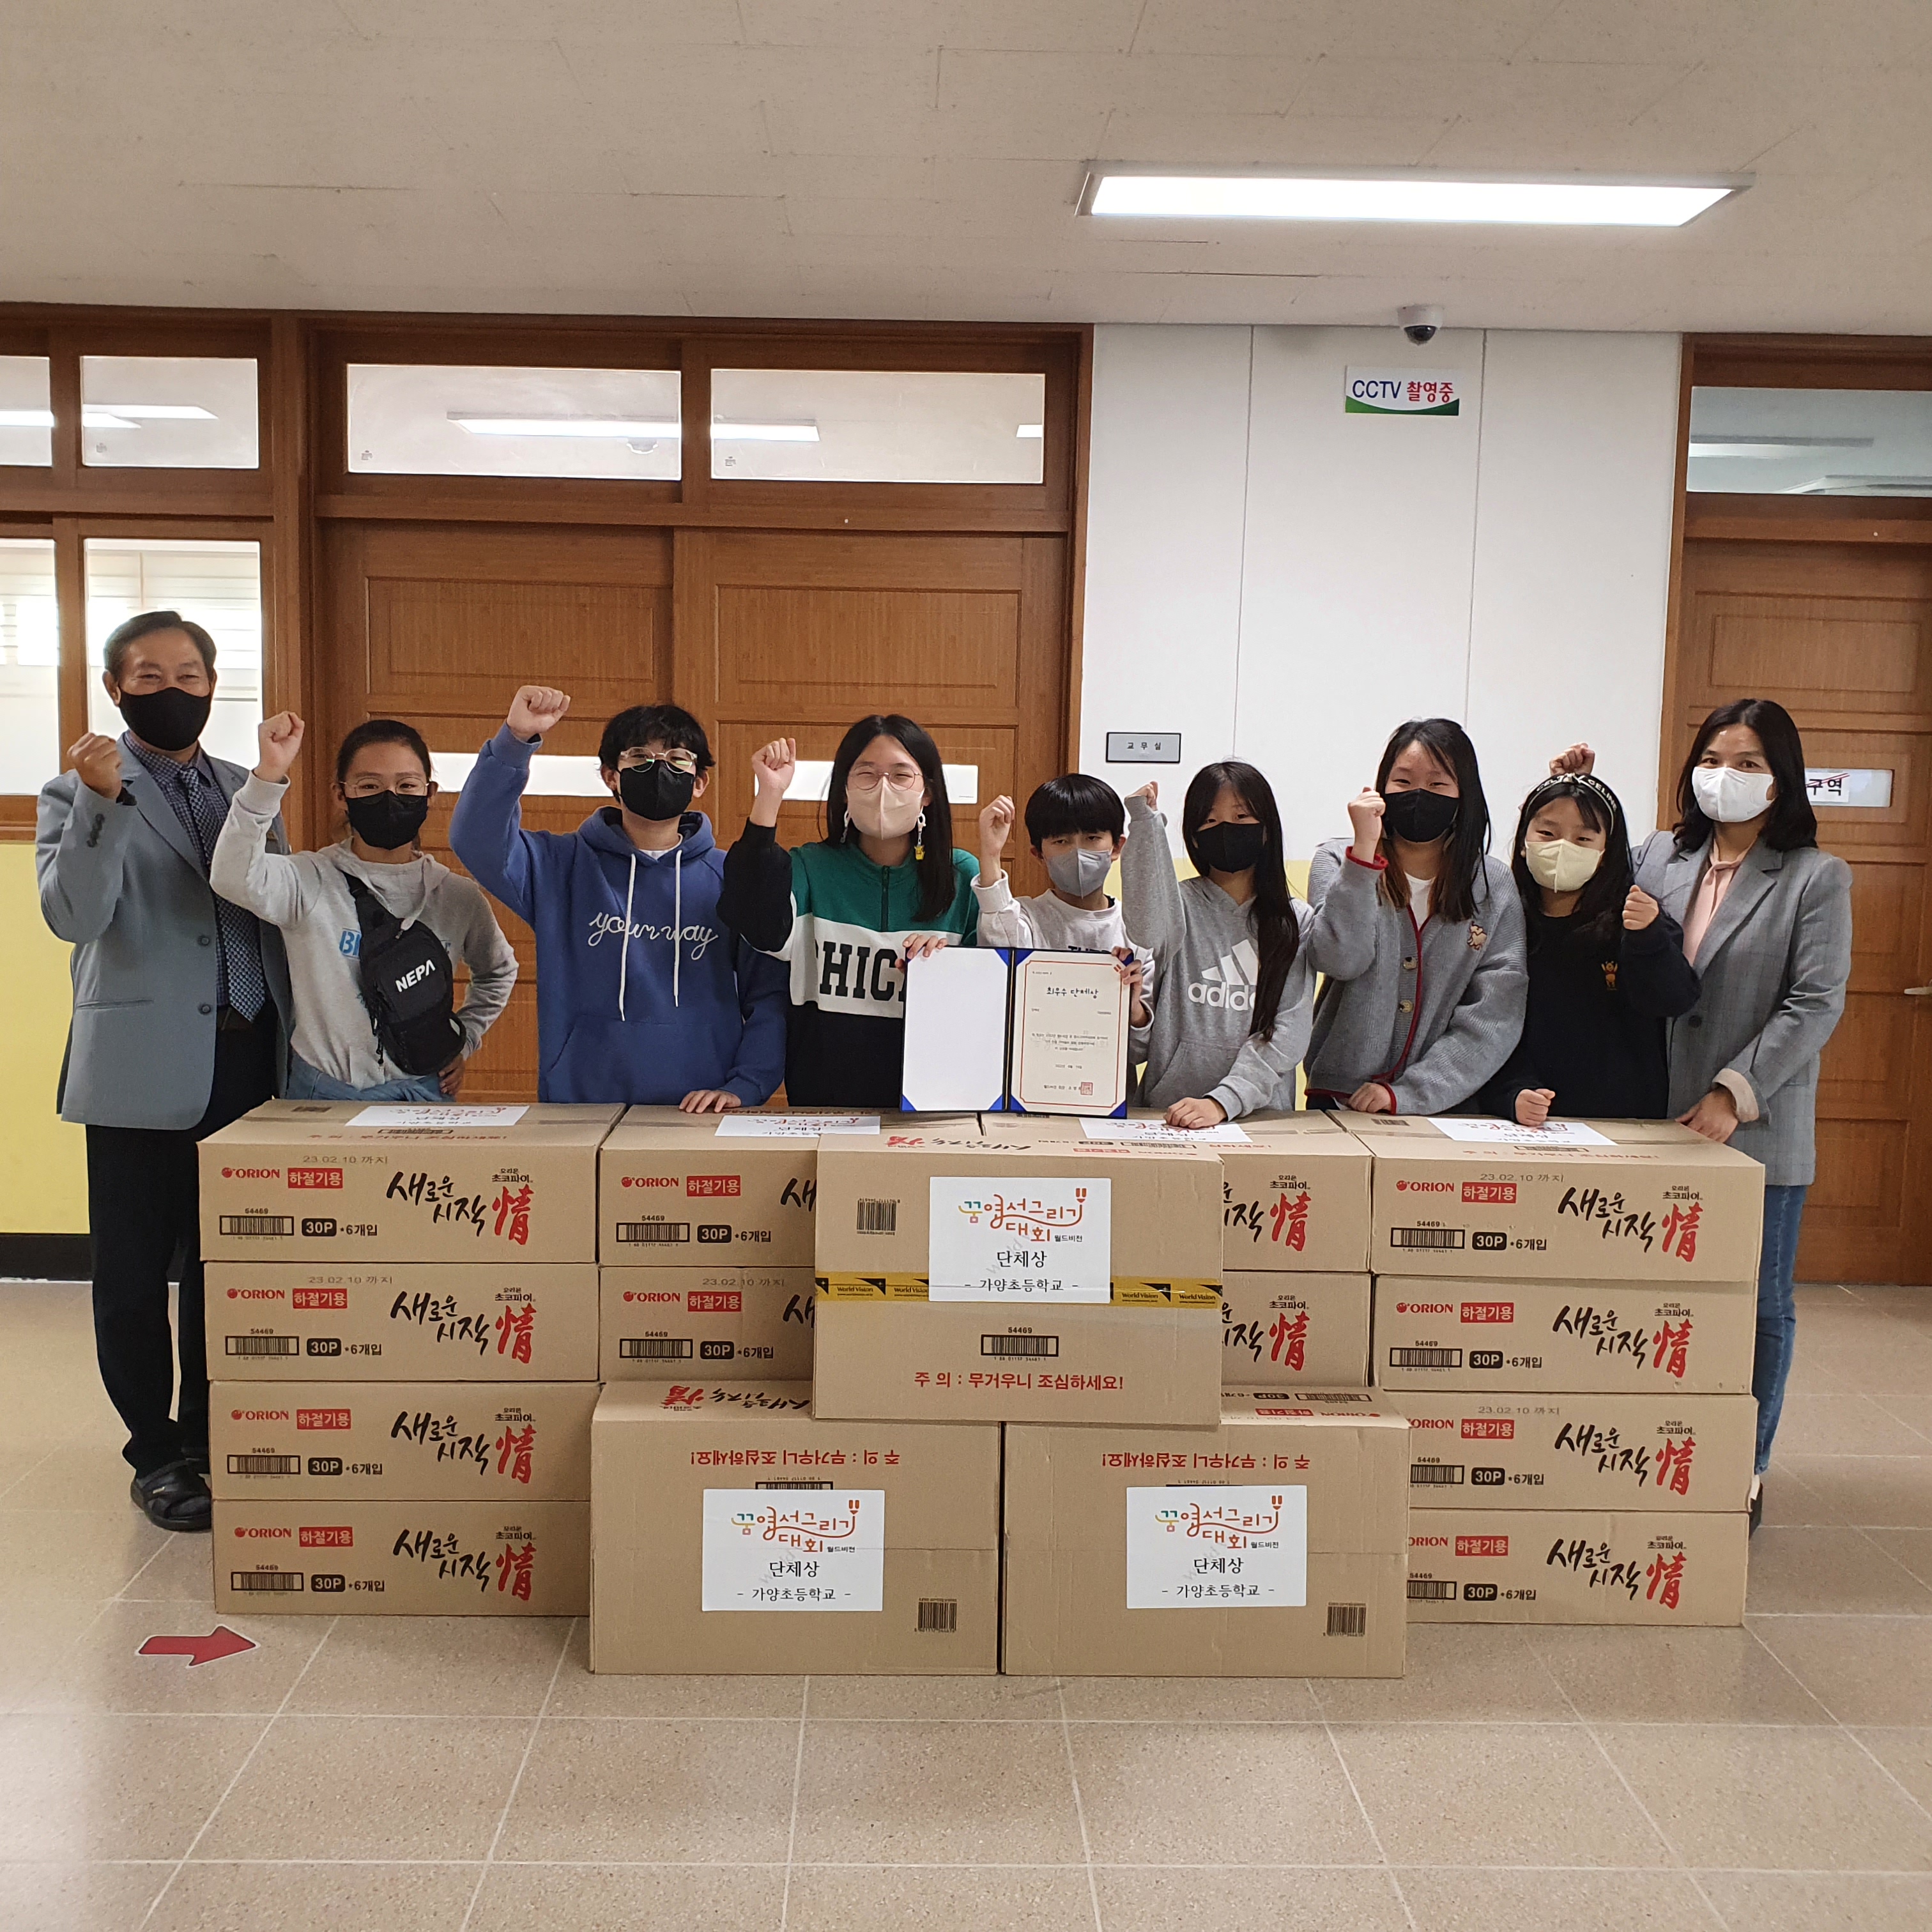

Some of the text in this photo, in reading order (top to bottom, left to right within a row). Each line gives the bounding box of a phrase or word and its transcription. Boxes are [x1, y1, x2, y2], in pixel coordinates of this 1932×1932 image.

[1353, 380, 1453, 402] CCTV 촬영중
[1588, 779, 1617, 811] CELINE
[395, 959, 436, 992] NEPA
[815, 941, 905, 1001] HIC
[1046, 986, 1098, 999] 최우수 단체상
[1188, 981, 1256, 1011] adid
[361, 1155, 388, 1165] 까지
[235, 1169, 342, 1186] ORION 하절기용
[492, 1174, 530, 1183] 초코파이
[635, 1177, 740, 1194] ORION 하절기용
[1270, 1181, 1307, 1190] 초코파이
[387, 1172, 454, 1206] 새로운
[1410, 1181, 1515, 1200] ORION 하절기용
[1662, 1192, 1699, 1200] 초코파이
[1558, 1187, 1625, 1221] 새로운
[433, 1195, 486, 1237] 시작
[492, 1183, 534, 1245] 情
[1269, 1190, 1312, 1252] 情
[306, 1222, 333, 1234] 30P
[702, 1228, 728, 1240] 30P
[1006, 1222, 1050, 1241] 대회
[1602, 1211, 1656, 1253] 시작
[1661, 1201, 1703, 1262] 情
[1476, 1235, 1503, 1247] 30P
[997, 1250, 1047, 1268] 단체상
[366, 1276, 392, 1285] 까지
[979, 1278, 1064, 1293] 가양초등학교
[240, 1289, 346, 1307] ORION 하절기용
[494, 1293, 533, 1301] 초코파이
[636, 1292, 740, 1309] ORION 하절기용
[1269, 1301, 1306, 1309] 초코파이
[390, 1292, 458, 1324] 새로운
[1409, 1303, 1513, 1321] ORION 하절기용
[1654, 1308, 1692, 1318] 초코파이
[1552, 1305, 1618, 1338] 새로운
[437, 1314, 490, 1355] 시작
[495, 1302, 537, 1364] 情
[1269, 1310, 1310, 1371] 情
[311, 1341, 338, 1353] 30P
[705, 1344, 730, 1356] 30P
[1596, 1329, 1648, 1368] 시작
[1652, 1318, 1693, 1378] 情
[1473, 1354, 1499, 1365] 30P
[968, 1372, 1031, 1390] 무거우니
[1037, 1374, 1123, 1391] 조심하세요!
[245, 1410, 349, 1427] ORION 하절기용
[495, 1413, 533, 1422] 초코파이
[1534, 1407, 1560, 1416] 까지
[390, 1411, 457, 1445] 새로운
[1411, 1418, 1513, 1437] ORION 하절기용
[1656, 1426, 1693, 1435] 초코파이
[1554, 1423, 1620, 1455] 새로운
[438, 1433, 490, 1475] 시작
[495, 1423, 537, 1484] 情
[691, 1450, 777, 1466] 조심하세요!
[783, 1449, 847, 1466] 무거우니
[1102, 1452, 1188, 1468] 조심하세요!
[1193, 1453, 1256, 1469] 무거우니
[312, 1460, 339, 1473] 30P
[1598, 1446, 1650, 1487] 시작
[1655, 1436, 1696, 1496] 情
[1475, 1471, 1501, 1482] 30P
[248, 1528, 351, 1545] ORION 하절기용
[496, 1532, 533, 1540] 초코파이
[778, 1535, 824, 1552] 대회
[1202, 1531, 1247, 1549] 대회
[392, 1529, 459, 1561] 새로운
[1457, 1539, 1507, 1554] 하절기용
[1647, 1541, 1684, 1549] 초코파이
[1546, 1538, 1611, 1572] 새로운
[440, 1552, 490, 1591] 시작
[495, 1541, 537, 1601] 情
[769, 1561, 820, 1577] 단체상
[1193, 1557, 1244, 1574] 단체상
[315, 1577, 342, 1589] 30P
[1589, 1561, 1641, 1600] 시작
[1646, 1551, 1687, 1610] 情
[752, 1587, 836, 1602] 가양초등학교
[1177, 1584, 1260, 1598] 가양초등학교
[1468, 1586, 1494, 1598] 30P
